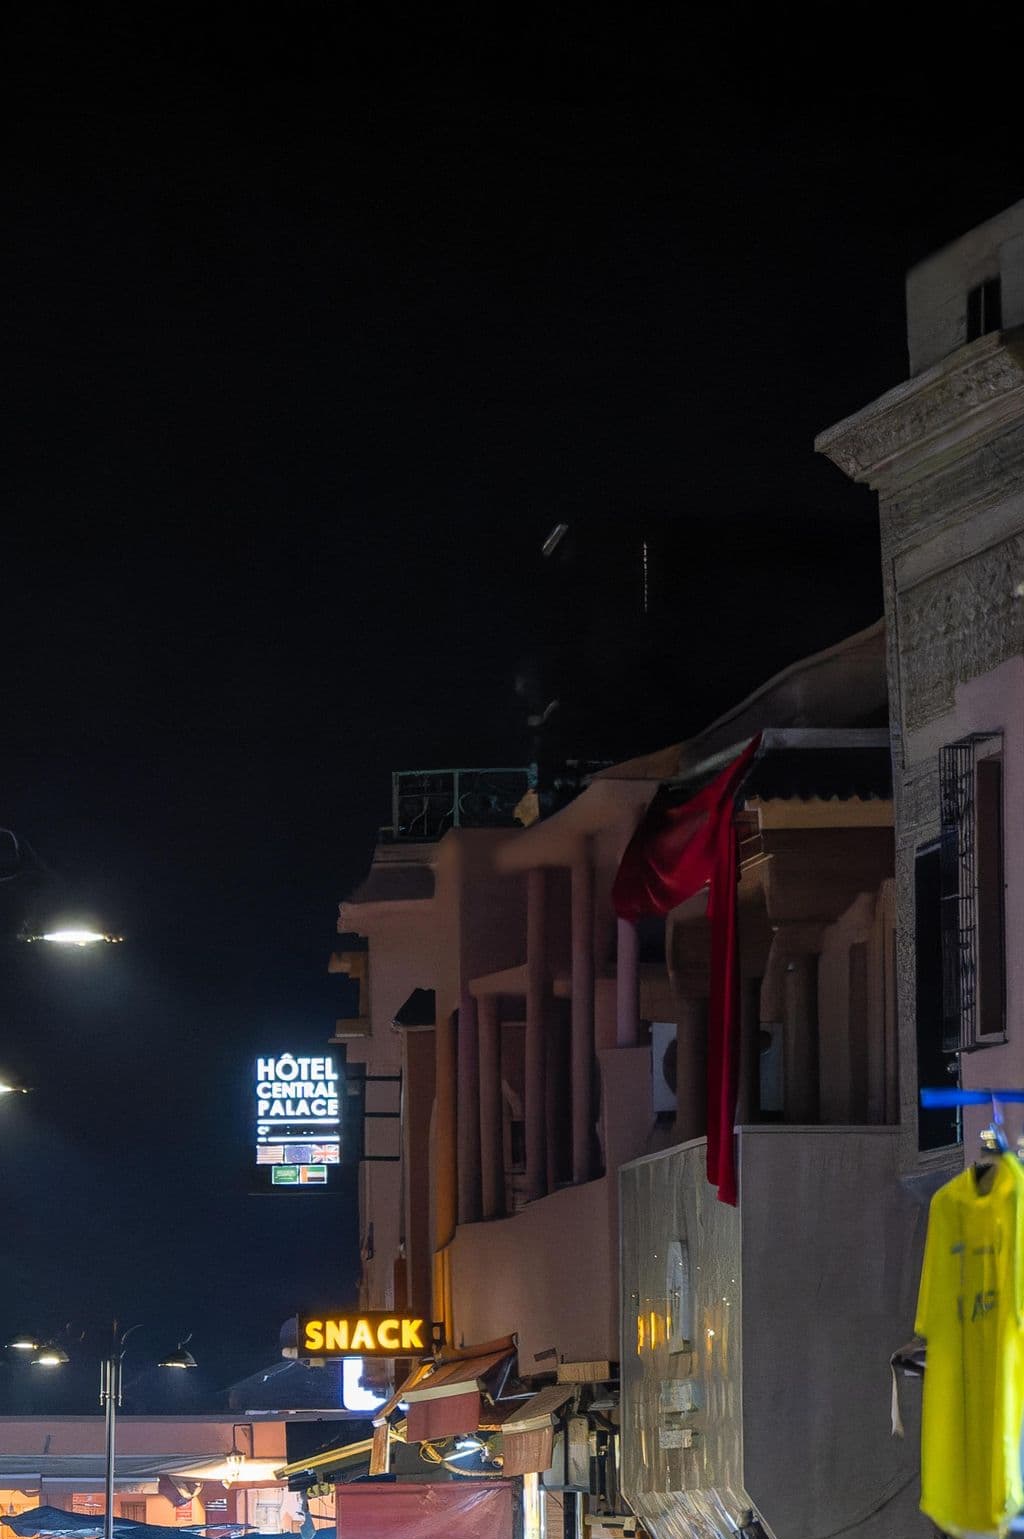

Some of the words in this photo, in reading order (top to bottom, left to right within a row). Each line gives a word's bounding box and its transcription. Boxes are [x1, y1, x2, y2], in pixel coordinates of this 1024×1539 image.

[257, 1053, 338, 1080] HÔTEL
[257, 1082, 338, 1098] CENTRAL
[258, 1099, 339, 1116] PALACE
[304, 1319, 425, 1350] SNACK
